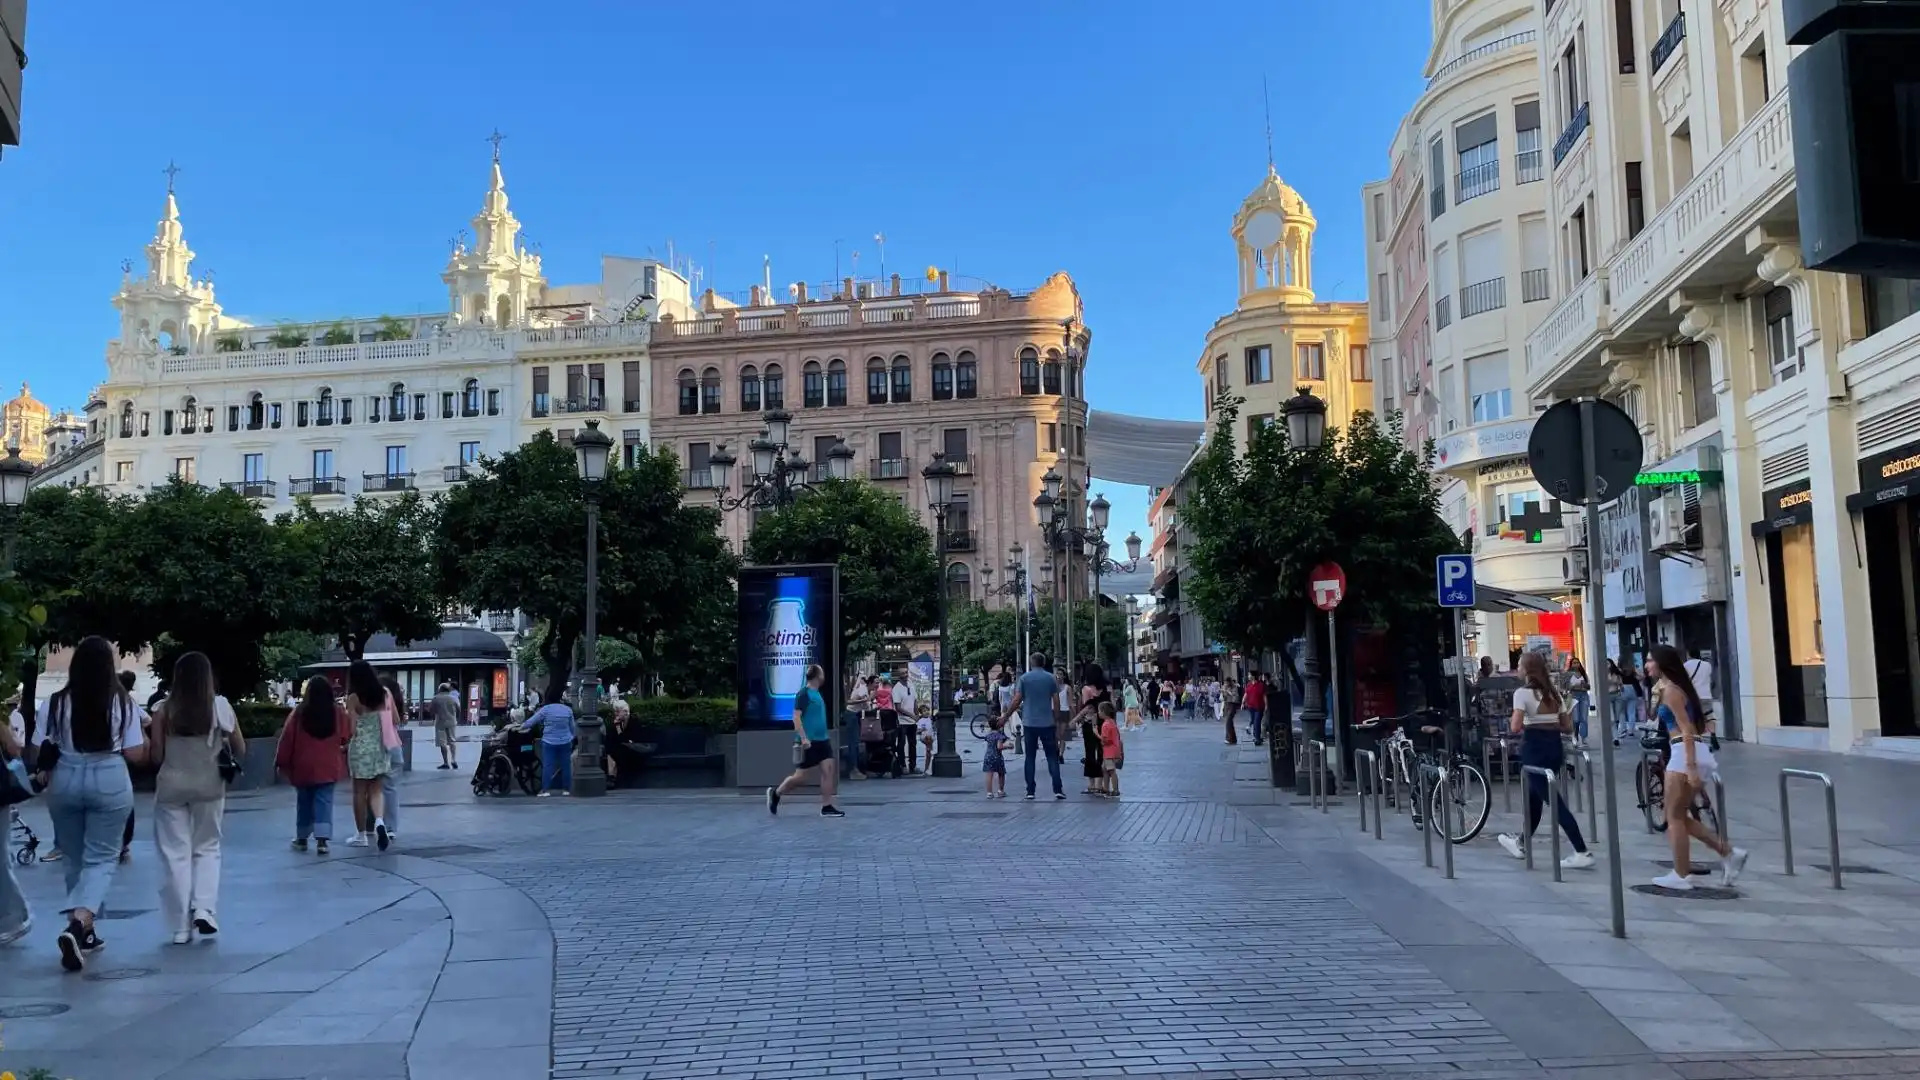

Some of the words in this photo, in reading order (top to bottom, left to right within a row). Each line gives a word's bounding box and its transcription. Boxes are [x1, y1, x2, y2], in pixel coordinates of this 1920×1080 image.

[1635, 471, 1700, 485] FARMACIA
[1444, 561, 1467, 588] P
[1623, 565, 1645, 594] CIA
[757, 626, 816, 646] Actimel
